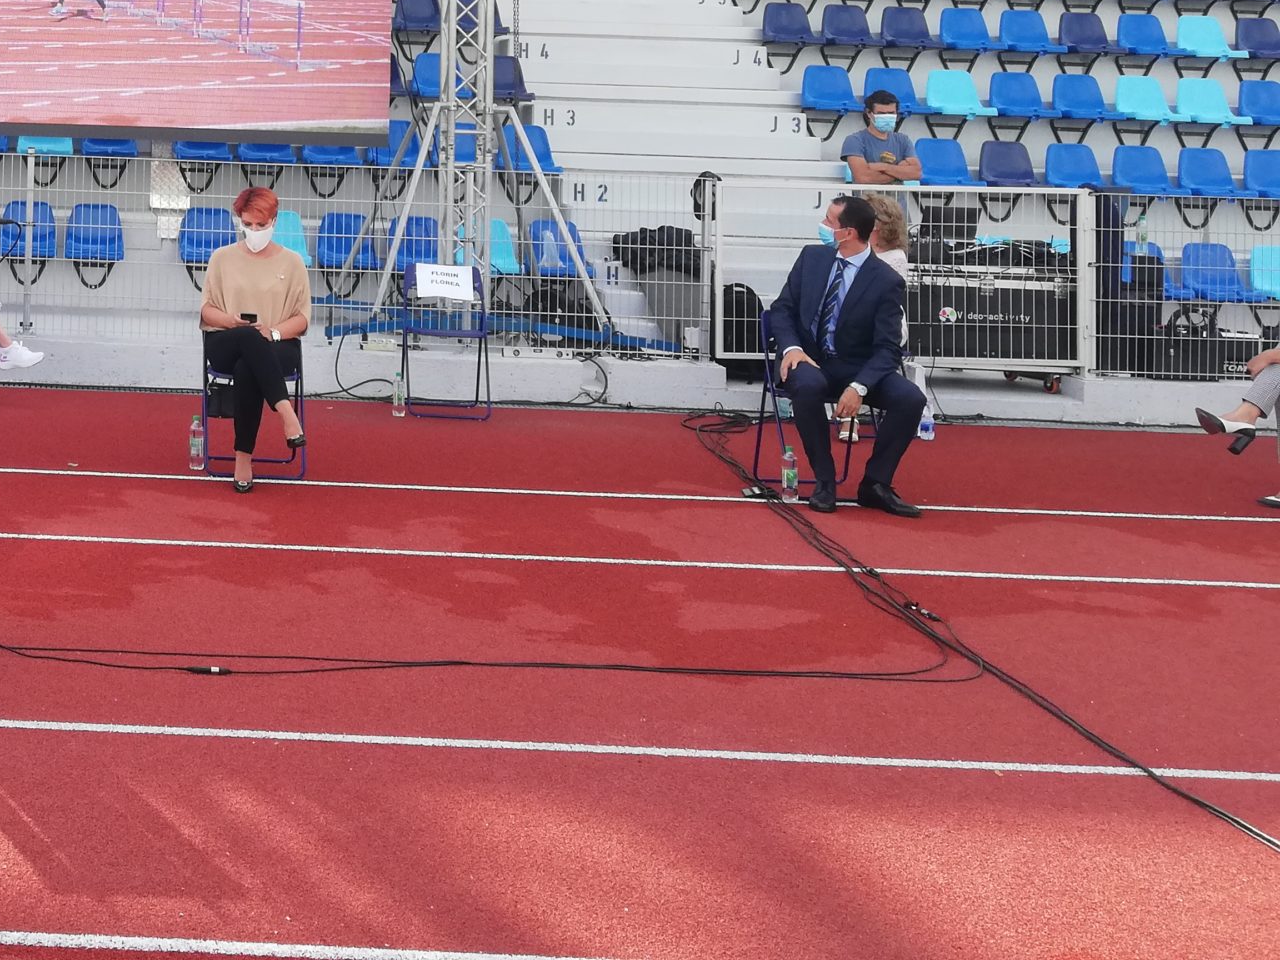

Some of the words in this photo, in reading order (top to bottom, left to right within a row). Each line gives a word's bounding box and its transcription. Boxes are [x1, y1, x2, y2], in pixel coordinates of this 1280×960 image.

[518, 42, 529, 59] H
[540, 42, 549, 60] 4
[732, 49, 740, 65] J
[753, 50, 762, 66] 4
[543, 108, 554, 126] H
[566, 109, 576, 126] 3
[770, 115, 778, 133] J
[791, 117, 801, 133] 3
[573, 183, 585, 201] H
[597, 184, 608, 202] 2
[813, 191, 822, 209] J
[431, 279, 461, 287] FLOREA
[606, 265, 619, 286] H
[957, 310, 1031, 323] Vdeo-activity
